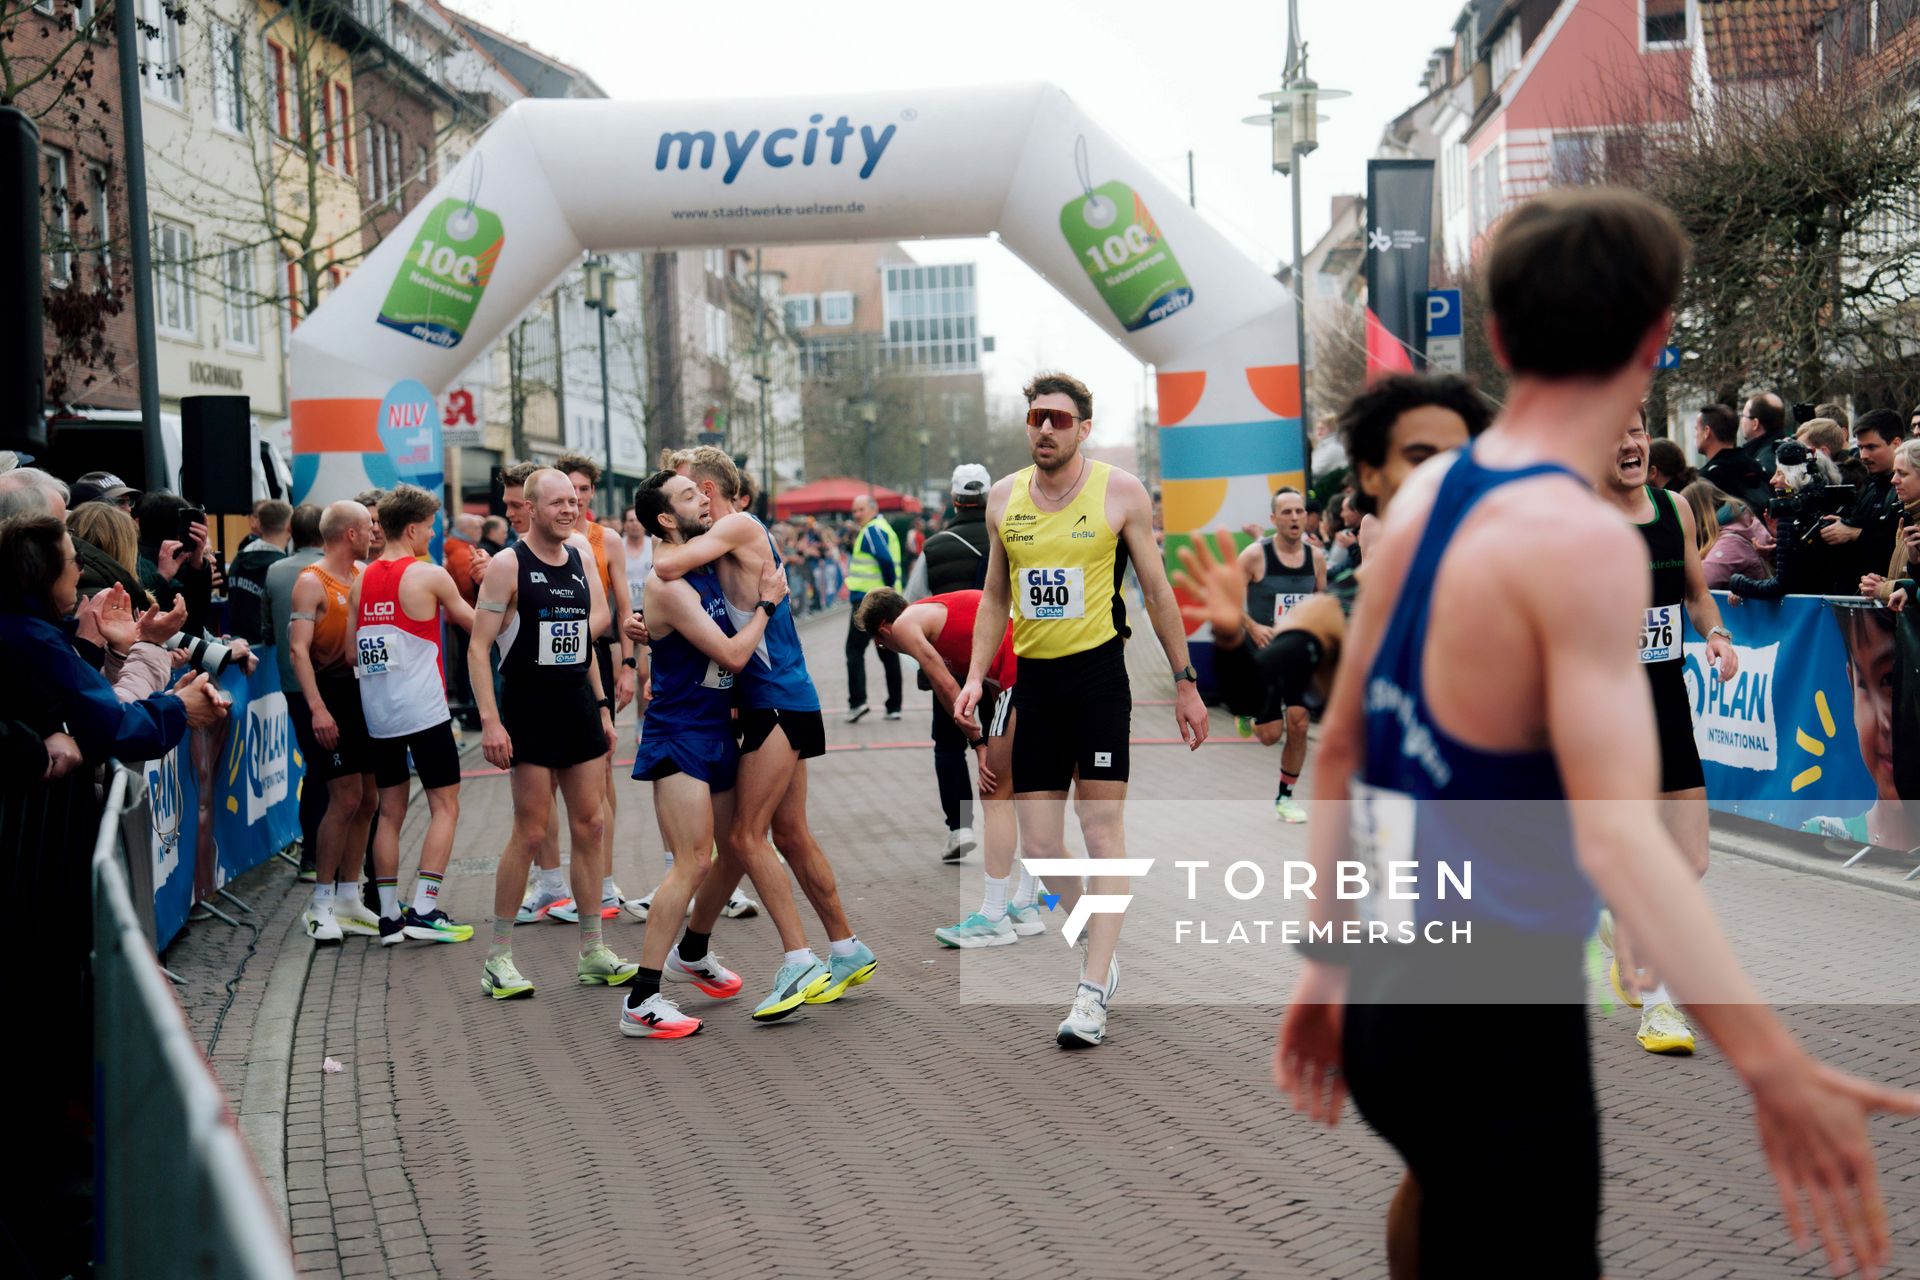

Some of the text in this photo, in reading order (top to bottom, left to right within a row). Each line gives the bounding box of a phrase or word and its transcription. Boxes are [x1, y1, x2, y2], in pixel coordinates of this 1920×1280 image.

[655, 113, 897, 184] mycity
[672, 201, 865, 219] www.stadtwerke-uelzen.de
[1104, 252, 1166, 288] Naturstrom
[409, 270, 473, 303] Naturstrom
[1149, 292, 1190, 320] mycity
[1426, 296, 1450, 332] P
[411, 325, 457, 347] mycity
[388, 402, 428, 429] NLV
[364, 601, 394, 616] LGO
[1030, 586, 1069, 606] 940
[362, 648, 389, 665] 864
[552, 636, 579, 654] 660
[1708, 667, 1767, 724] PLAN
[262, 711, 286, 767] PLAN
[1707, 728, 1769, 752] INTERNATIONAL
